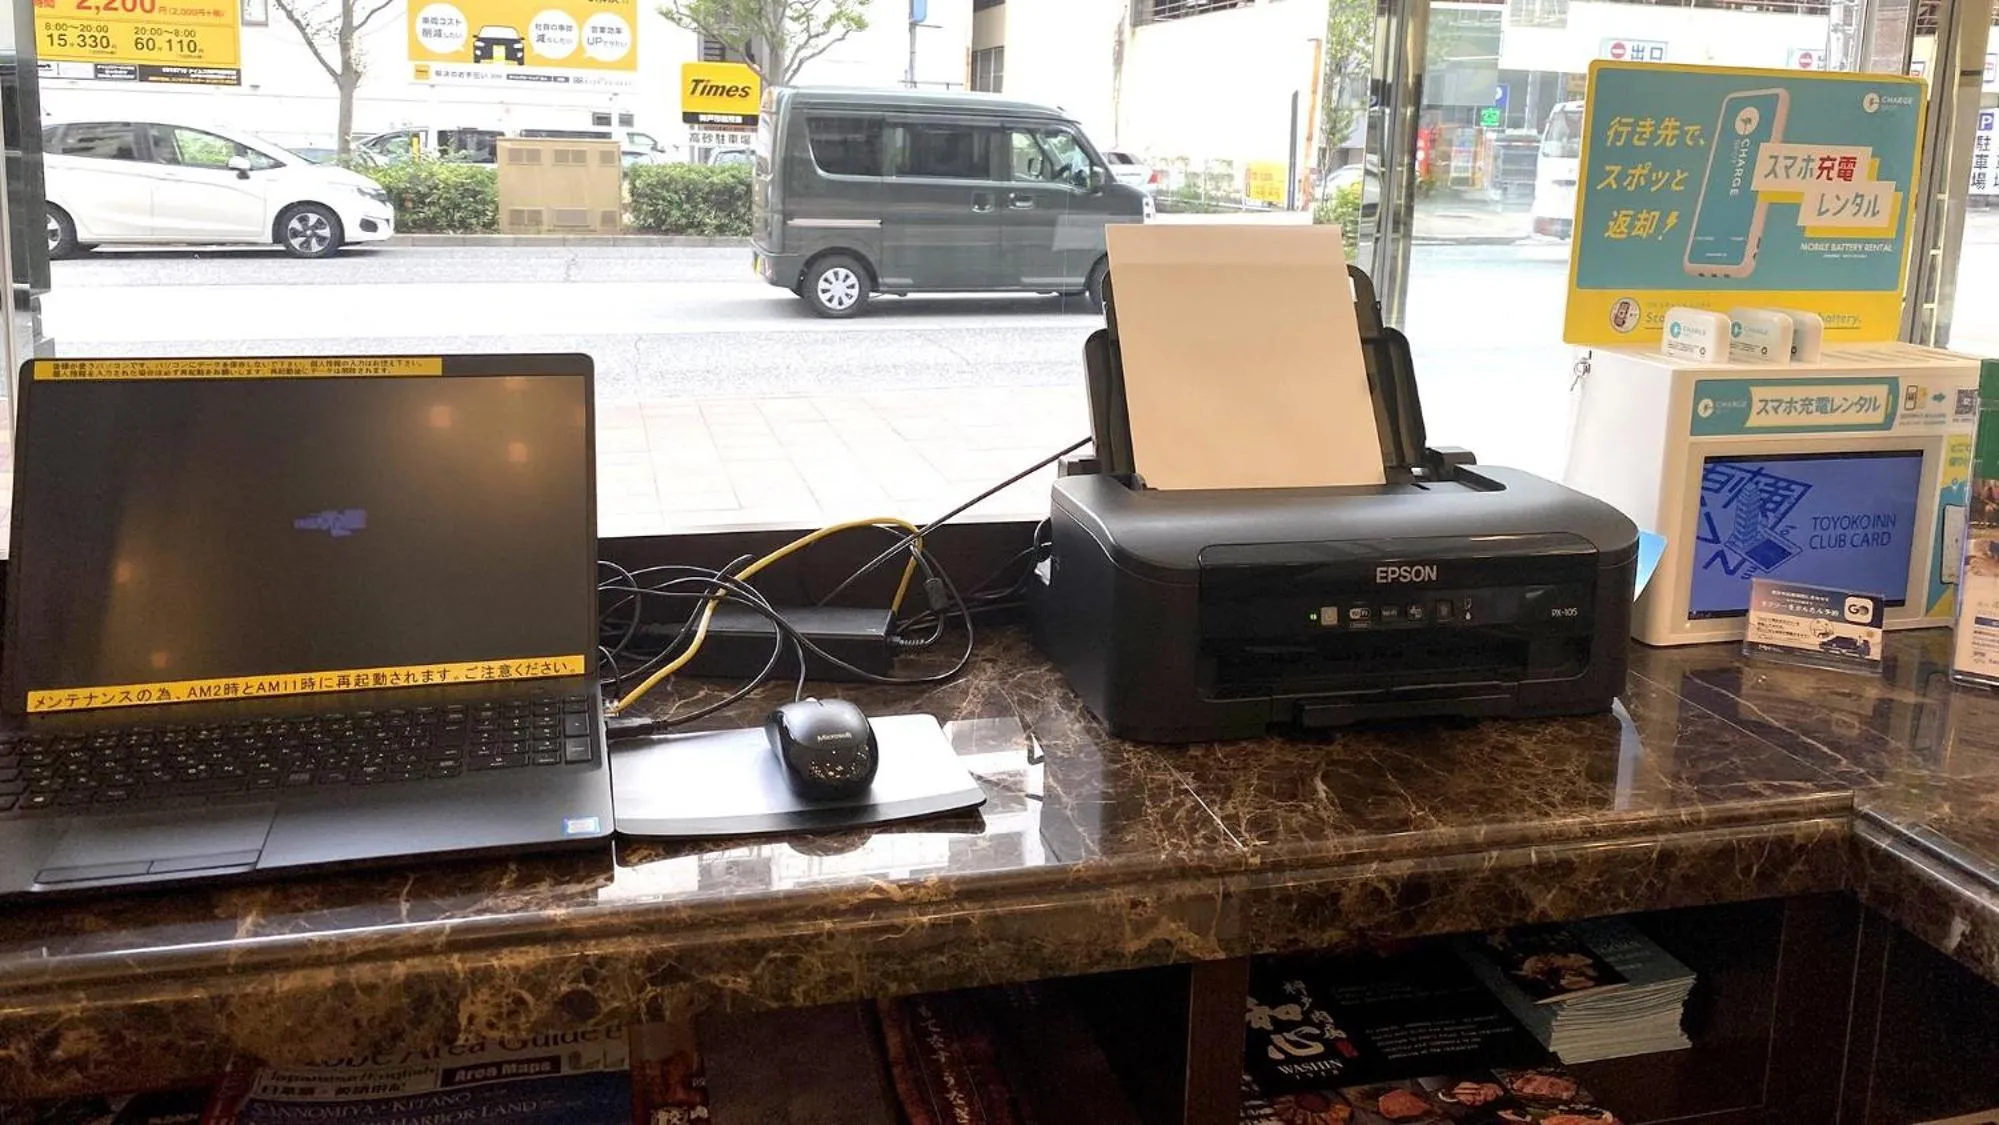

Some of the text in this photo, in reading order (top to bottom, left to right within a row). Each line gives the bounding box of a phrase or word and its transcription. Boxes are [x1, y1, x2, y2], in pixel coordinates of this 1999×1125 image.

[1630, 44, 1664, 61] 出口
[690, 79, 752, 98] Times
[1981, 114, 1992, 130] P
[1729, 138, 1750, 196] CHARGE
[1764, 154, 1857, 182] スマホ充電
[1971, 135, 1992, 191] 駐車場
[1596, 161, 1689, 192] スポッと
[1816, 191, 1880, 217] レンタル
[1756, 396, 1881, 416] スマホ充電レンタル
[1811, 514, 1870, 531] TOYOKO
[1809, 531, 1891, 549] CLUB CARD
[1376, 565, 1437, 583] EPSON
[1551, 607, 1578, 618] PX-105
[1848, 604, 1870, 616] GO
[455, 1060, 552, 1082] Area Maps
[1277, 1059, 1344, 1075] WASHIN
[481, 1102, 538, 1120] LAND
